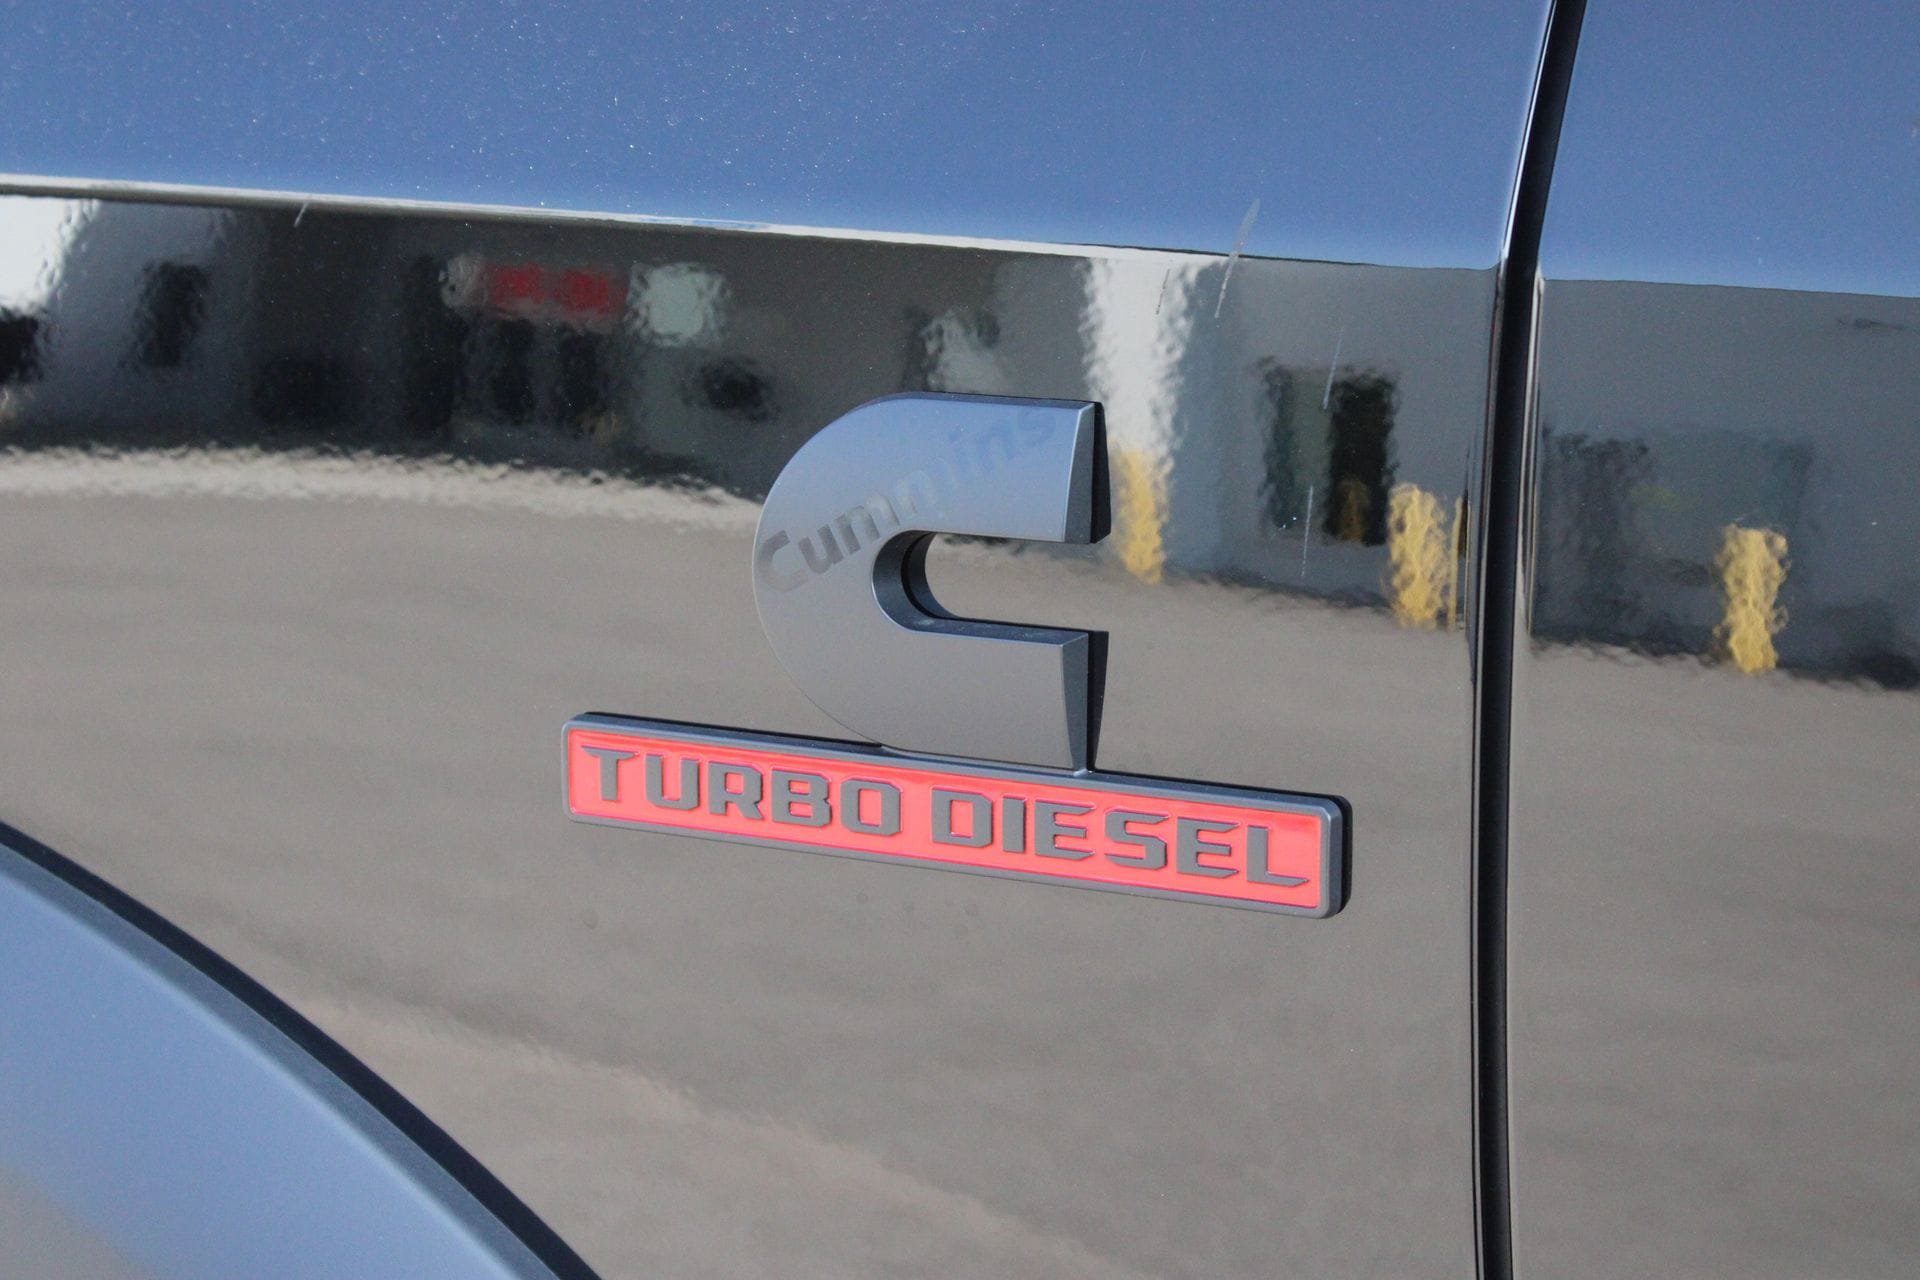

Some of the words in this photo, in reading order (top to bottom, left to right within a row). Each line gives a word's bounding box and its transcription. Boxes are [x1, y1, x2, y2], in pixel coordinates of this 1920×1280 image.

[755, 409, 1056, 593] Cummins
[580, 745, 903, 837] TURBO
[931, 786, 1310, 887] DIESEL
